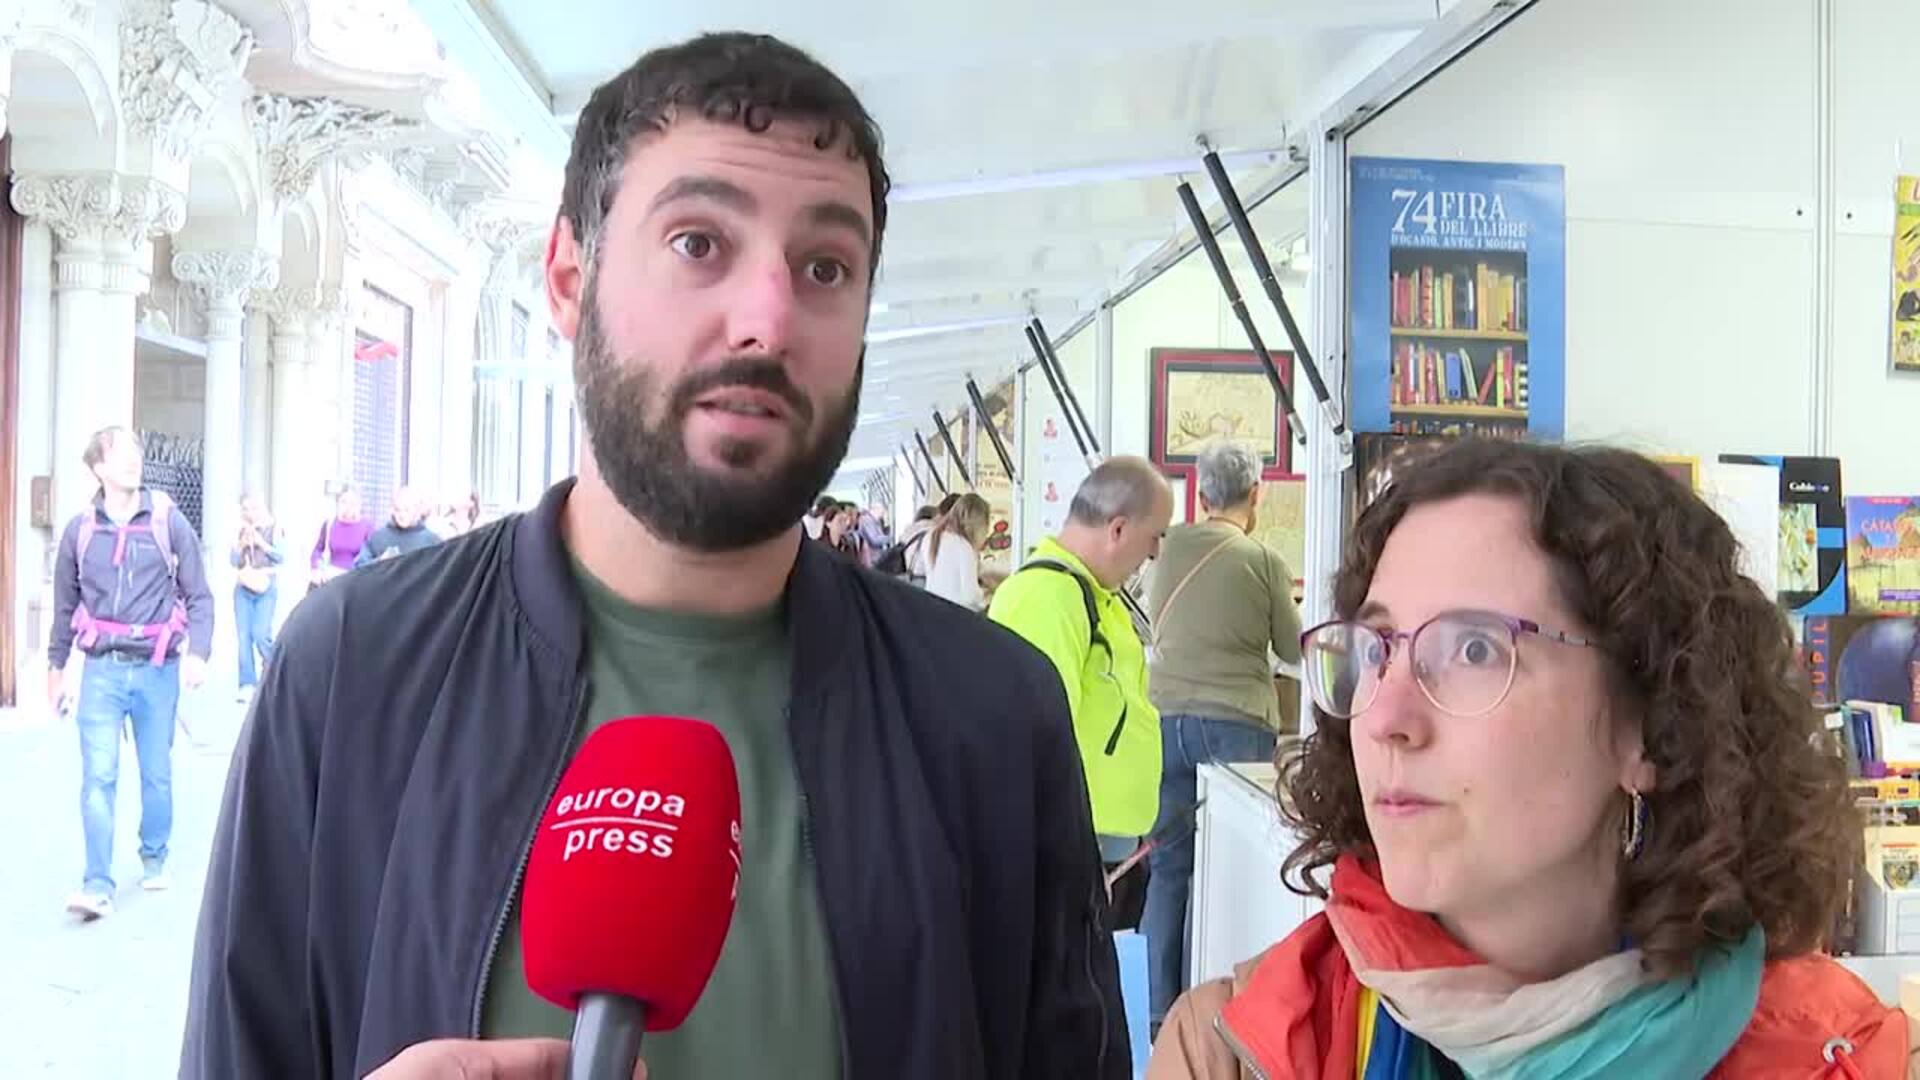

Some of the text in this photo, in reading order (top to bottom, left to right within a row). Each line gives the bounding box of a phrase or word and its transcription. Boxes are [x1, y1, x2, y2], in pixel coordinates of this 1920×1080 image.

[1391, 188, 1506, 235] 74 FIRA
[1440, 219, 1528, 238] DEL LLIBRE
[556, 787, 686, 818] europa
[563, 827, 674, 861] press
